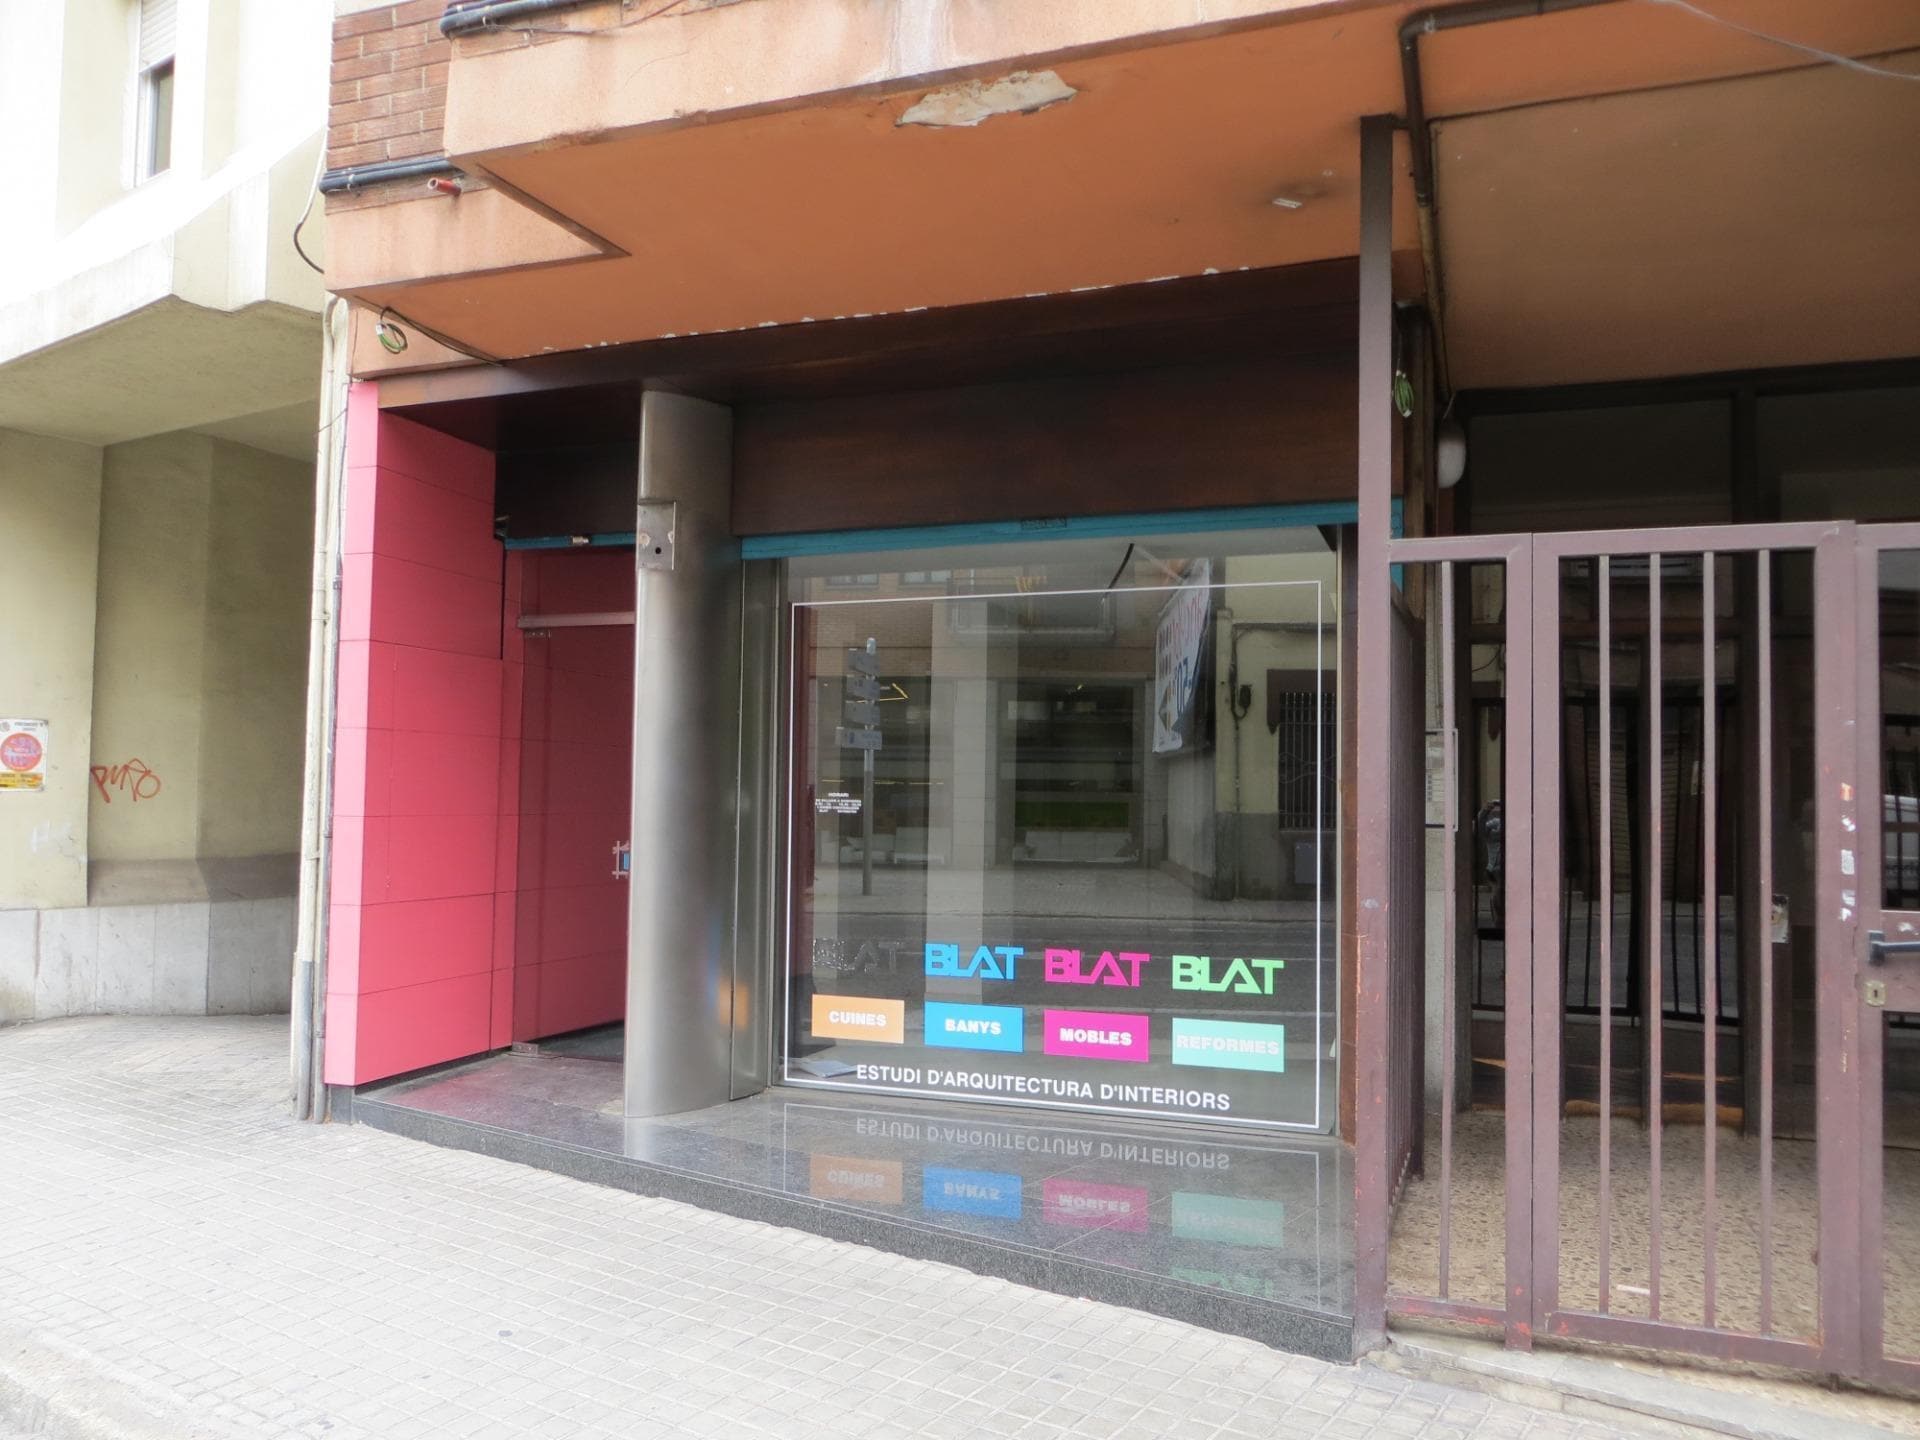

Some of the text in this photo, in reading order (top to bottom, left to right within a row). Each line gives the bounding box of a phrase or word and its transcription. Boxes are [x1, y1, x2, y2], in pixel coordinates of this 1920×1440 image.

[925, 943, 1024, 980] BLAT
[1044, 948, 1150, 987] BLAT
[1172, 955, 1284, 994] BLAT
[828, 1010, 887, 1028] CUINES
[945, 1018, 1001, 1036] BANYS
[1059, 1027, 1133, 1046] MOBLES
[1176, 1034, 1280, 1056] REFORMES
[856, 1064, 1231, 1111] ESTUDI D'ARQUITECTURA D'INTERIORS
